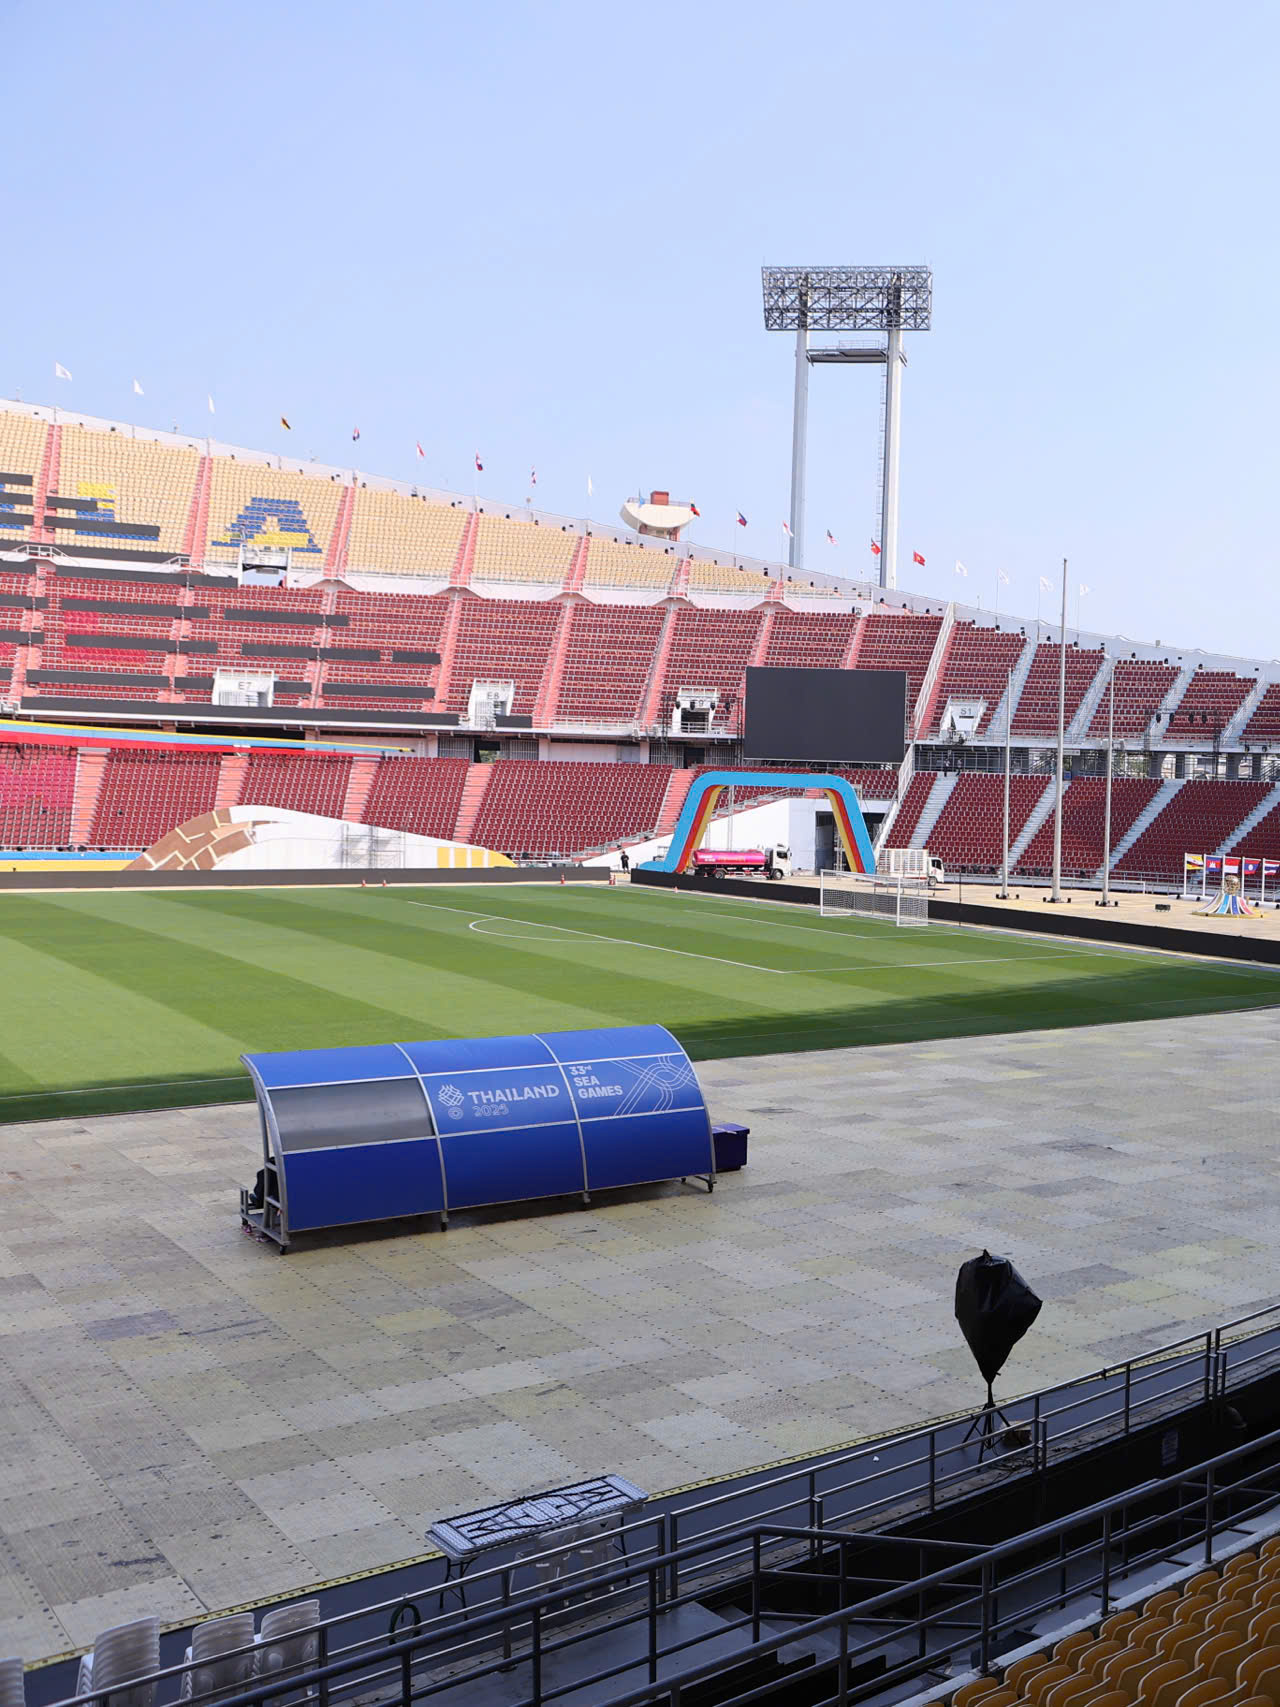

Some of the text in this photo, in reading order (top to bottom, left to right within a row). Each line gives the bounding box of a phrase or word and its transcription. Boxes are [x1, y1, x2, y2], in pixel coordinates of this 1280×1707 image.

[239, 681, 253, 690] E7
[487, 691, 500, 700] E8
[960, 707, 972, 715] S1
[568, 1065, 592, 1075] 33rd
[573, 1076, 600, 1087] SEA
[467, 1084, 560, 1105] THAILAND
[578, 1085, 624, 1099] GAMES
[472, 1103, 509, 1117] 2025
